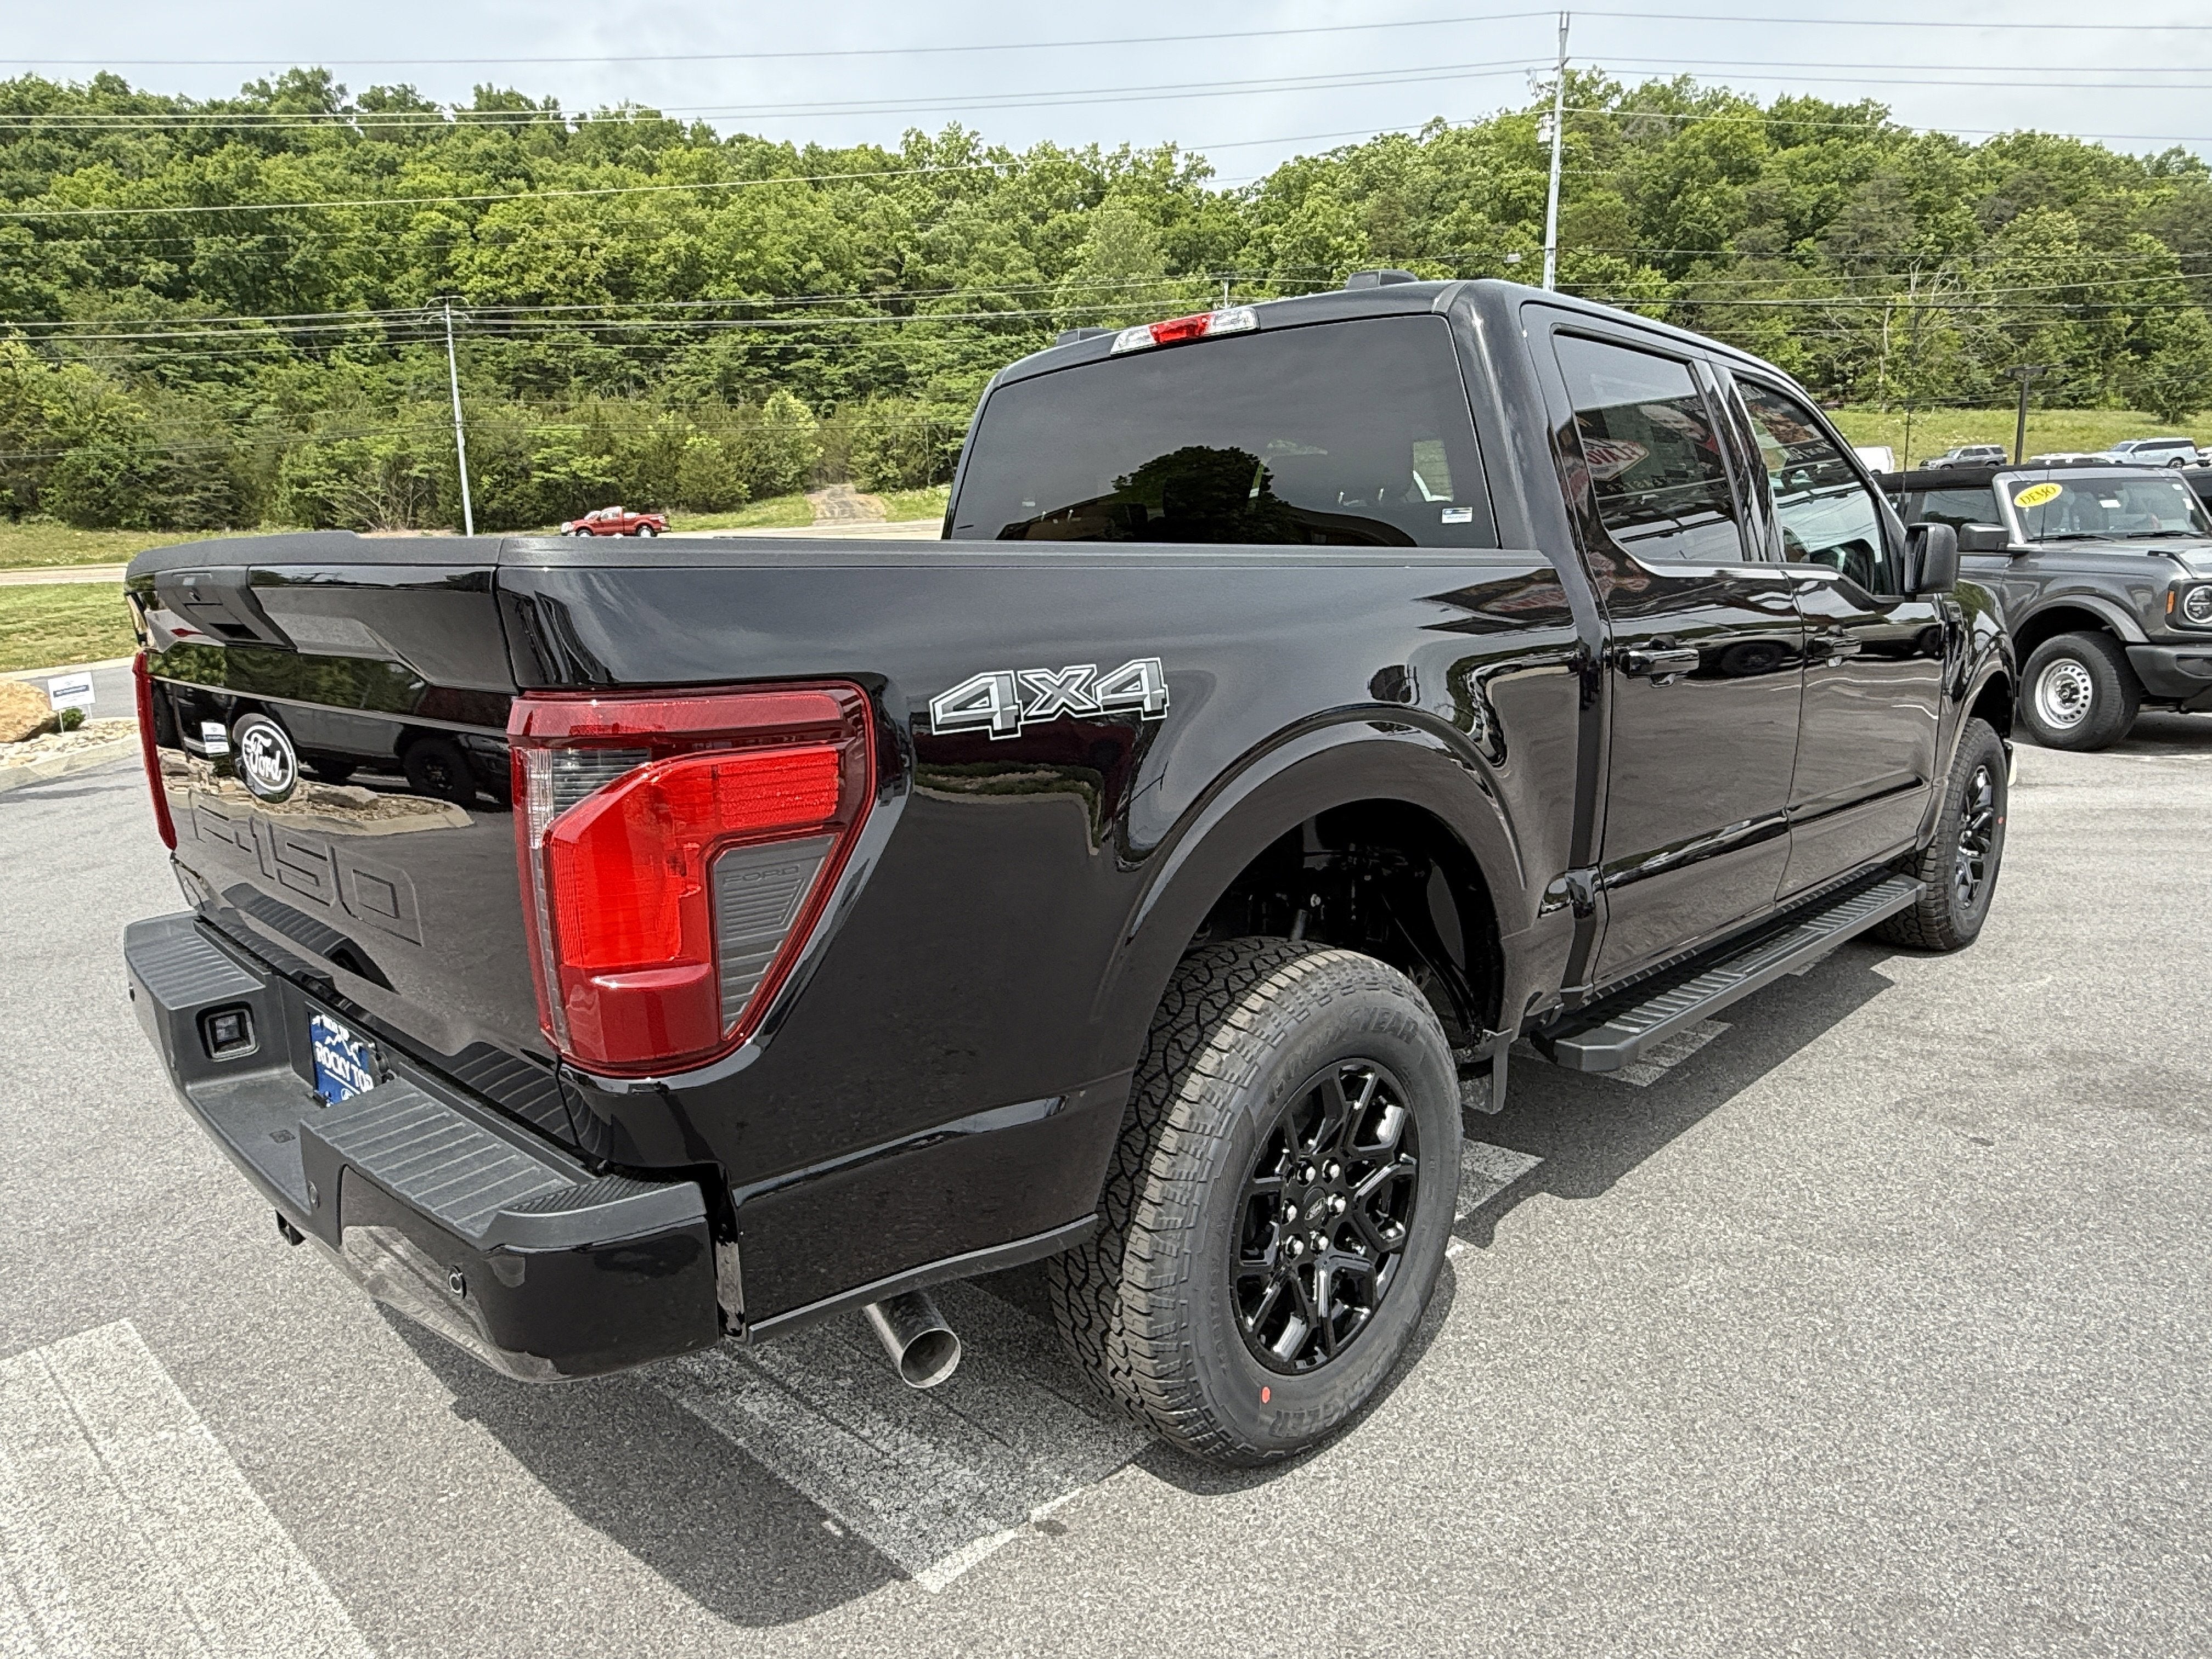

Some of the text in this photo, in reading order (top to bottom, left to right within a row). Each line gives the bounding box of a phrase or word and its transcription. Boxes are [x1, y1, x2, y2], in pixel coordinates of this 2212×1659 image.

[2019, 486, 2056, 504] DEMO
[244, 732, 282, 782] Ford
[188, 788, 424, 947] F-150
[723, 865, 800, 885] FORD
[315, 1040, 351, 1082] ROCKY
